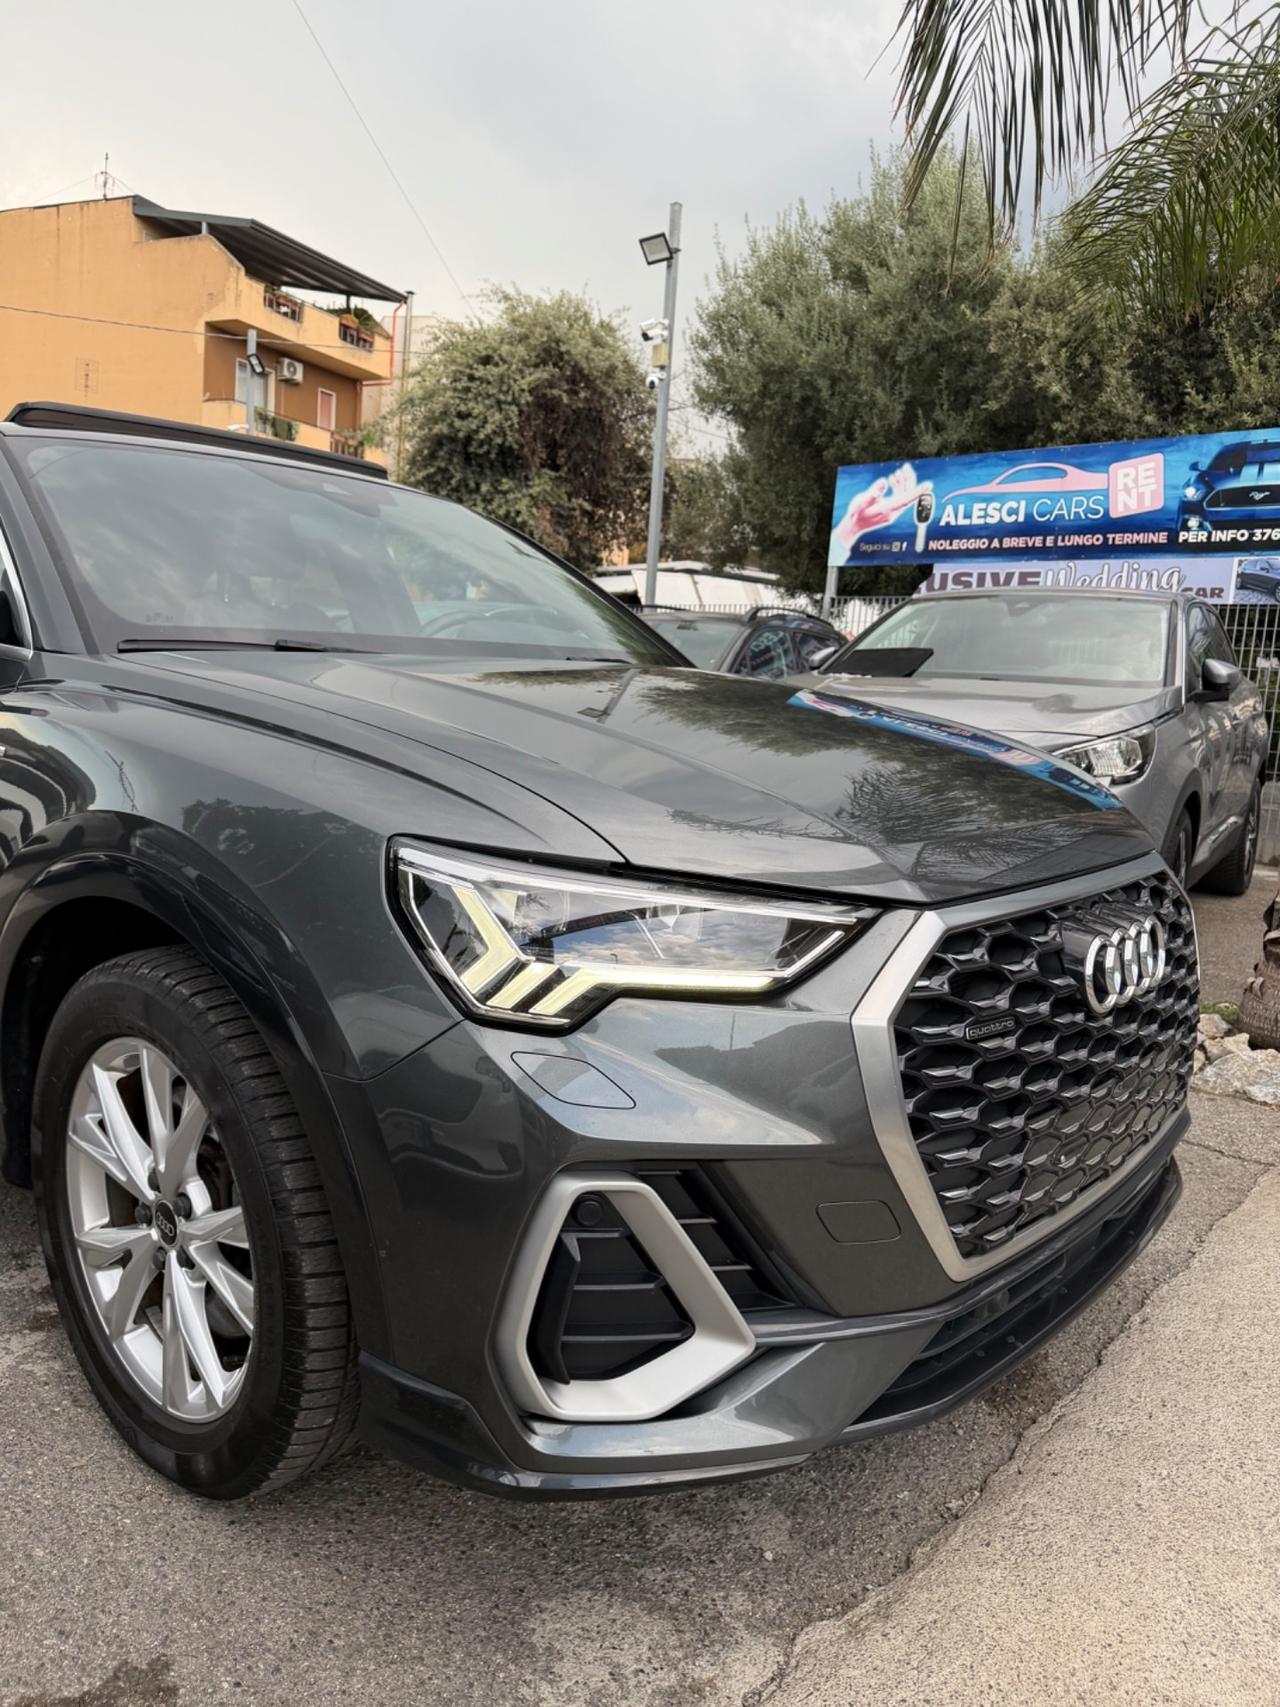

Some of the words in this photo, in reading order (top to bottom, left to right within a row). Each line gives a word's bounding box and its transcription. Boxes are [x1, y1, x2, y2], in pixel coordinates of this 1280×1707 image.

[939, 500, 1026, 527] ALESCI
[1033, 495, 1105, 522] CARS
[928, 538, 988, 551] NOLEGGIO
[989, 538, 1000, 549] A
[1002, 535, 1043, 548] BREVE
[1045, 536, 1055, 547] E
[1057, 534, 1104, 546] LUNGO
[1107, 531, 1169, 545] TERMINE
[1178, 530, 1208, 543] PER
[1211, 529, 1249, 542] INFO
[1252, 527, 1280, 541] 376
[913, 570, 1041, 594] USIVE
[969, 1019, 1015, 1038] quattro
